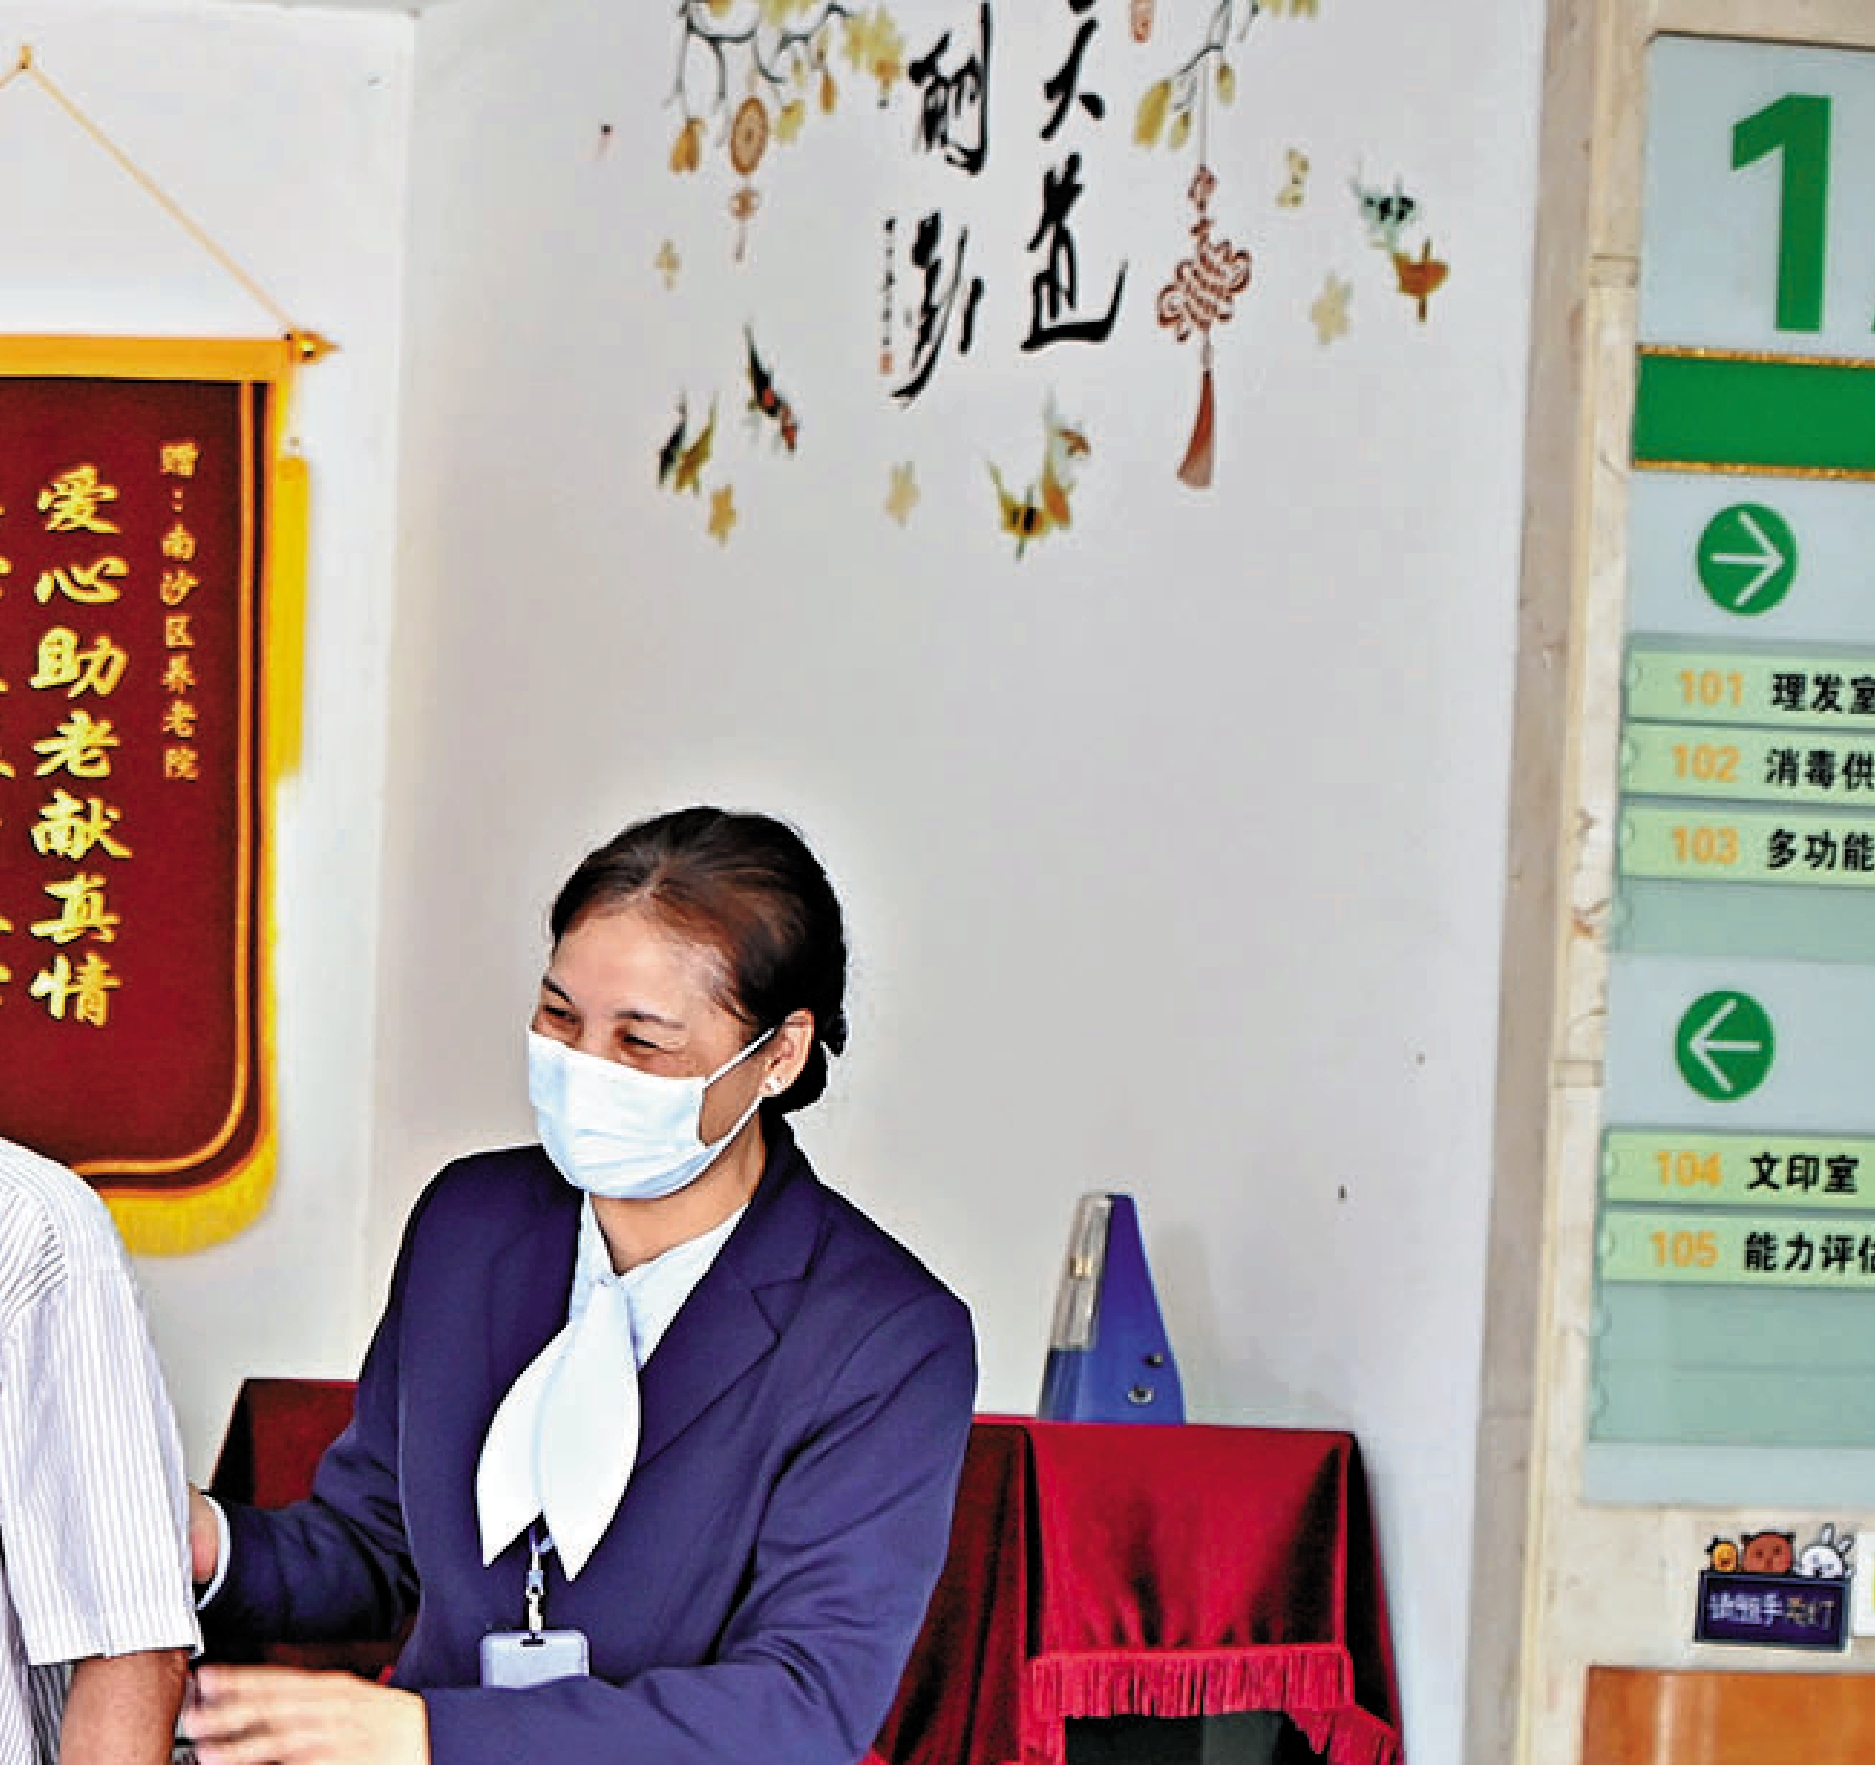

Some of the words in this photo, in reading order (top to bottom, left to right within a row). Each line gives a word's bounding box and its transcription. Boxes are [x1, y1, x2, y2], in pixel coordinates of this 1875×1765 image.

[1681, 668, 1744, 707] 101
[1771, 673, 1875, 714] 理发室
[29, 464, 132, 1027] 爱心助老献真情
[1673, 743, 1741, 783] 102
[1764, 748, 1875, 792] 消毒供
[1672, 827, 1739, 865] 103
[1767, 829, 1875, 872] 多功能
[1657, 1151, 1722, 1187] 104
[1745, 1152, 1859, 1195] 文印室
[1651, 1230, 1719, 1268] 105
